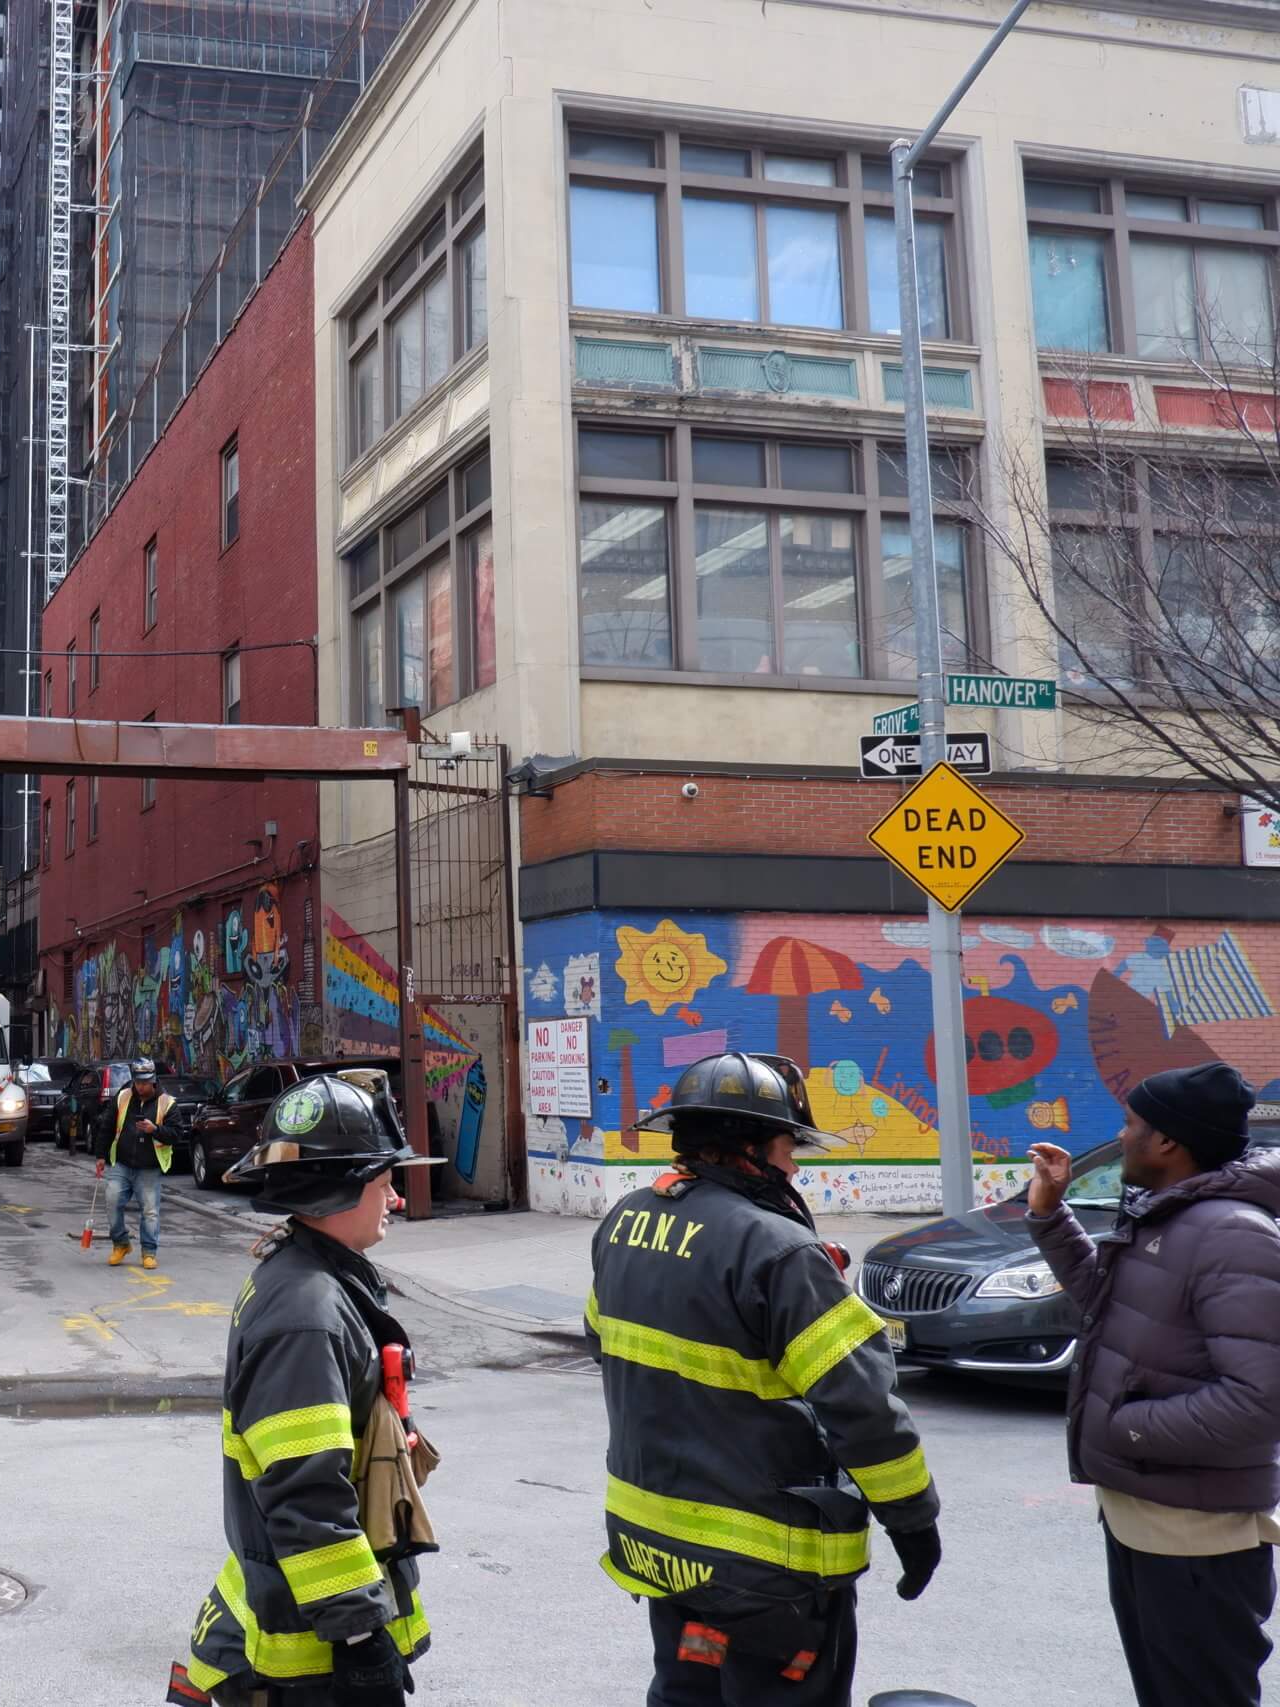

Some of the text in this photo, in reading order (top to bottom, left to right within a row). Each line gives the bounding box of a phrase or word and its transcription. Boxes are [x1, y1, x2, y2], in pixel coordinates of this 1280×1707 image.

[953, 678, 1051, 705] HANOVER PL
[875, 706, 920, 735] GROVE PL
[879, 747, 916, 763] ONE
[904, 808, 986, 832] DEAD
[918, 845, 977, 869] END
[560, 1021, 583, 1033] DANGER
[535, 1027, 549, 1047] NO
[566, 1035, 577, 1050] NO
[531, 1051, 556, 1063] PARKING
[559, 1053, 585, 1065] SMOKING
[531, 1070, 555, 1080] CAUTION
[531, 1086, 557, 1097] HARD HAT
[538, 1102, 551, 1113] AREA
[859, 1171, 876, 1180] This
[609, 1209, 704, 1258] F.D.N.Y.
